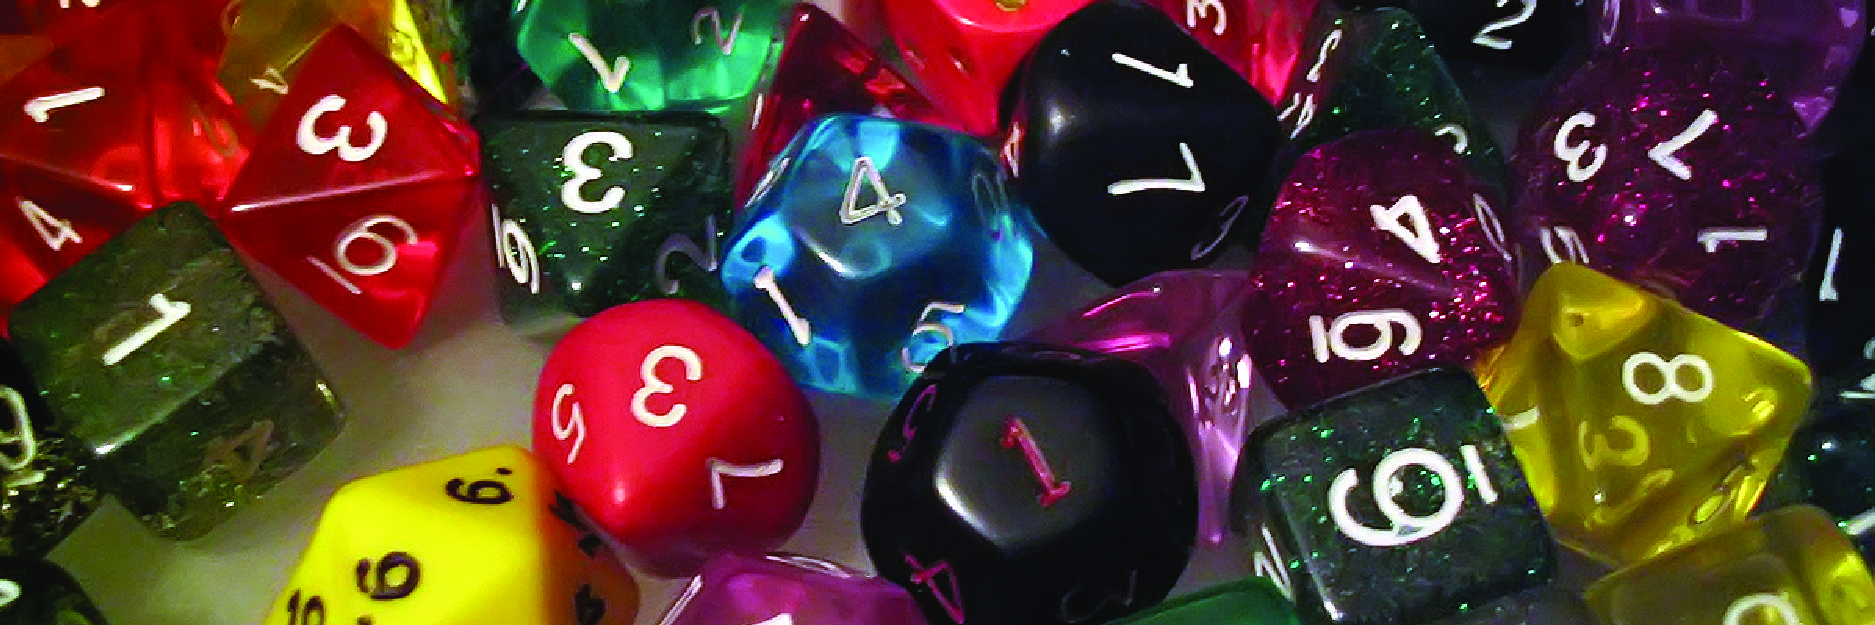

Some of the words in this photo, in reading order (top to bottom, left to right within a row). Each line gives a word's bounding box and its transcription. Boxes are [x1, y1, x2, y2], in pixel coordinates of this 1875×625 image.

[1474, 0, 1537, 49] 2
[24, 86, 106, 123] 1
[1111, 51, 1194, 89] 1
[296, 94, 389, 163] 3
[1553, 110, 1607, 183] 3
[1647, 107, 1719, 181] 7
[560, 130, 634, 215] 3
[838, 155, 907, 226] 4
[1106, 142, 1206, 195] 7
[16, 197, 83, 251] 4
[1369, 195, 1441, 264] 4
[1696, 225, 1769, 254] 1
[103, 292, 193, 367] 1
[753, 263, 814, 346] 1
[630, 344, 703, 428] 3
[1621, 351, 1714, 405] 8
[551, 383, 587, 466] 5
[706, 457, 785, 511] 7
[1000, 416, 1072, 508] 1
[904, 552, 965, 625] 4
